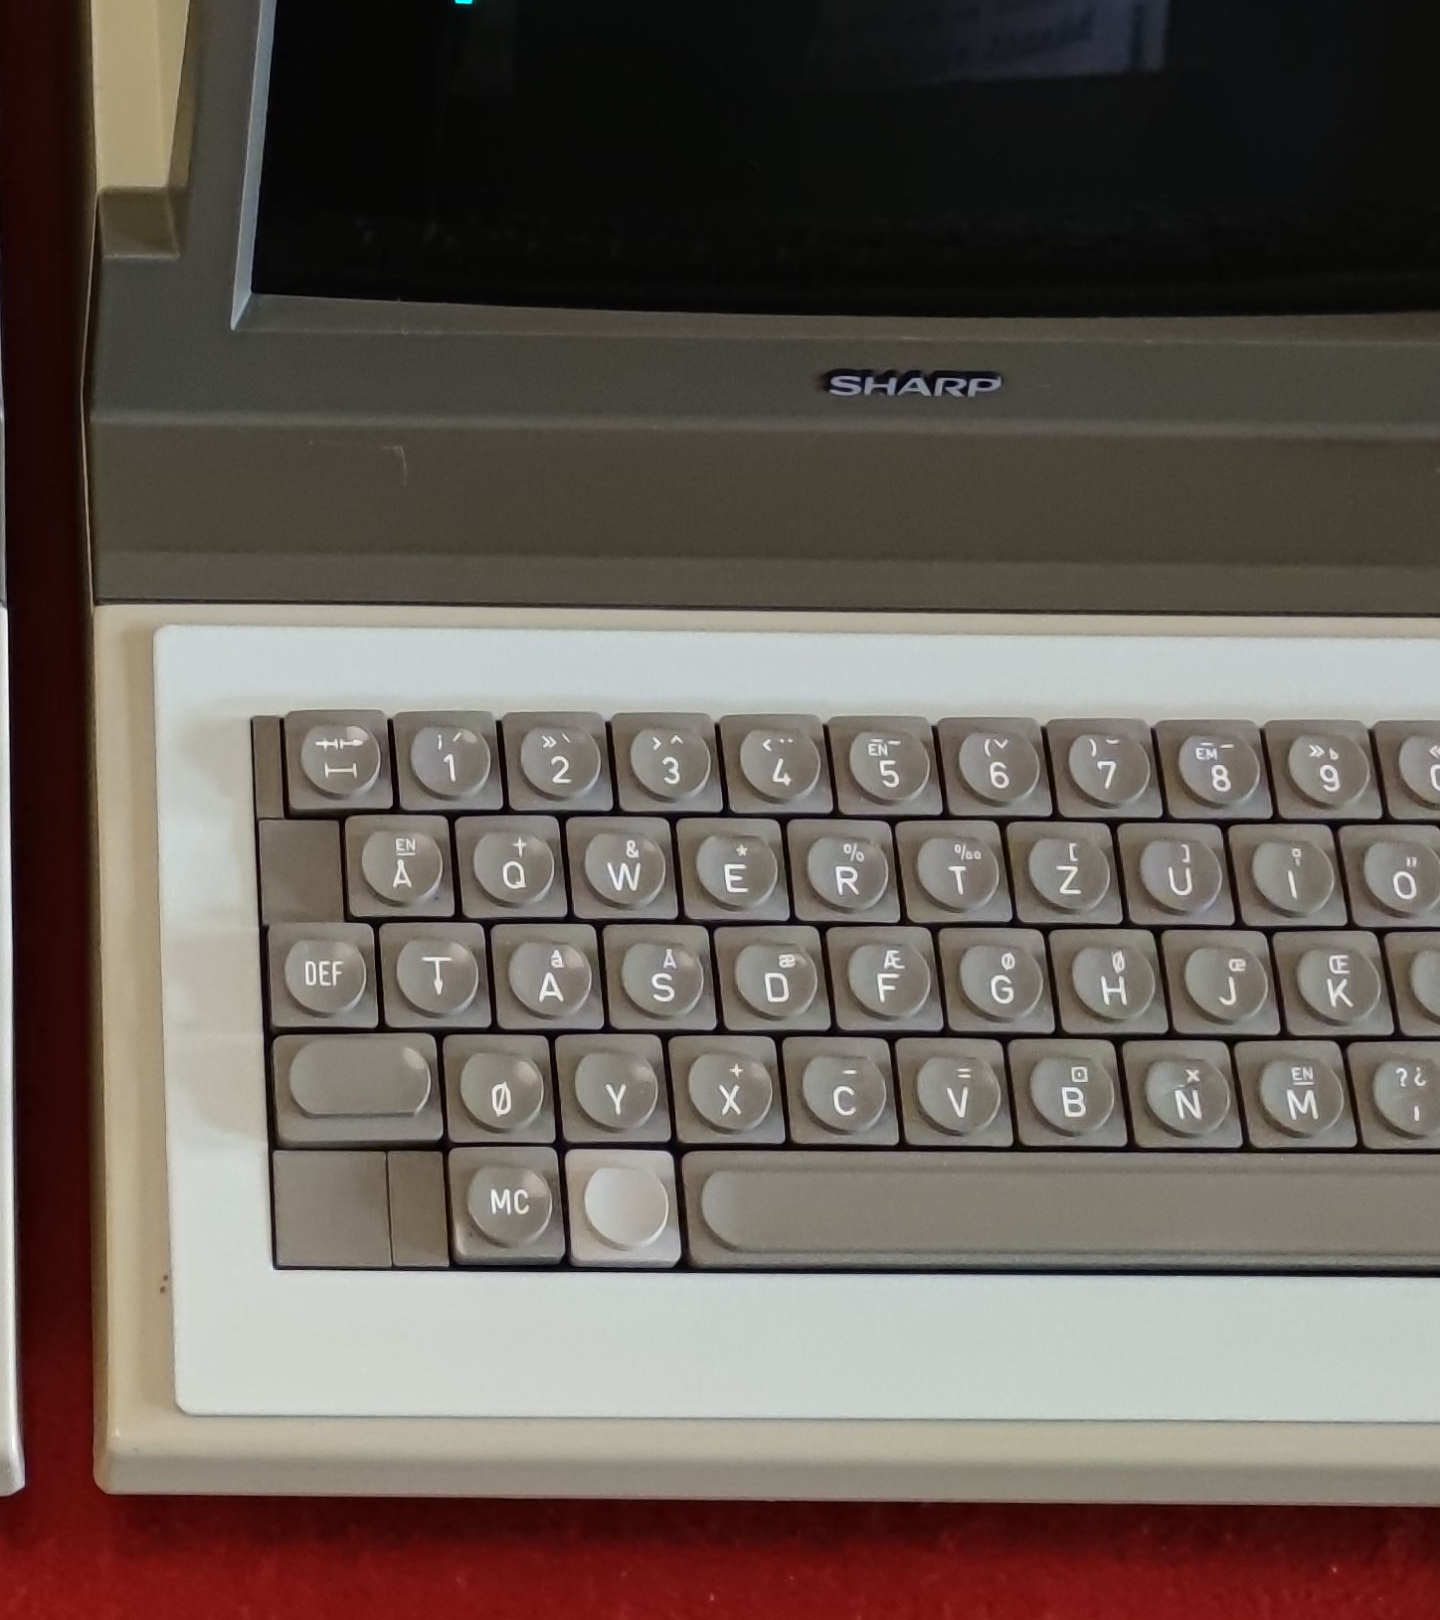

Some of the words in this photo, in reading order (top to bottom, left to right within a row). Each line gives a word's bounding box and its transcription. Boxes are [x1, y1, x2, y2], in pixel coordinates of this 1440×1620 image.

[828, 374, 1002, 398] SHARP
[501, 860, 528, 889] Q
[607, 862, 642, 891] W
[724, 864, 749, 893] E
[834, 865, 860, 896] R
[948, 865, 967, 896] T
[1056, 865, 1082, 895] Z
[1168, 866, 1193, 896] U
[304, 960, 345, 987] DEF
[538, 972, 565, 1003] A
[651, 973, 676, 1003] S
[764, 972, 790, 1003] D
[877, 973, 901, 1004] F
[490, 1188, 530, 1216] MC
